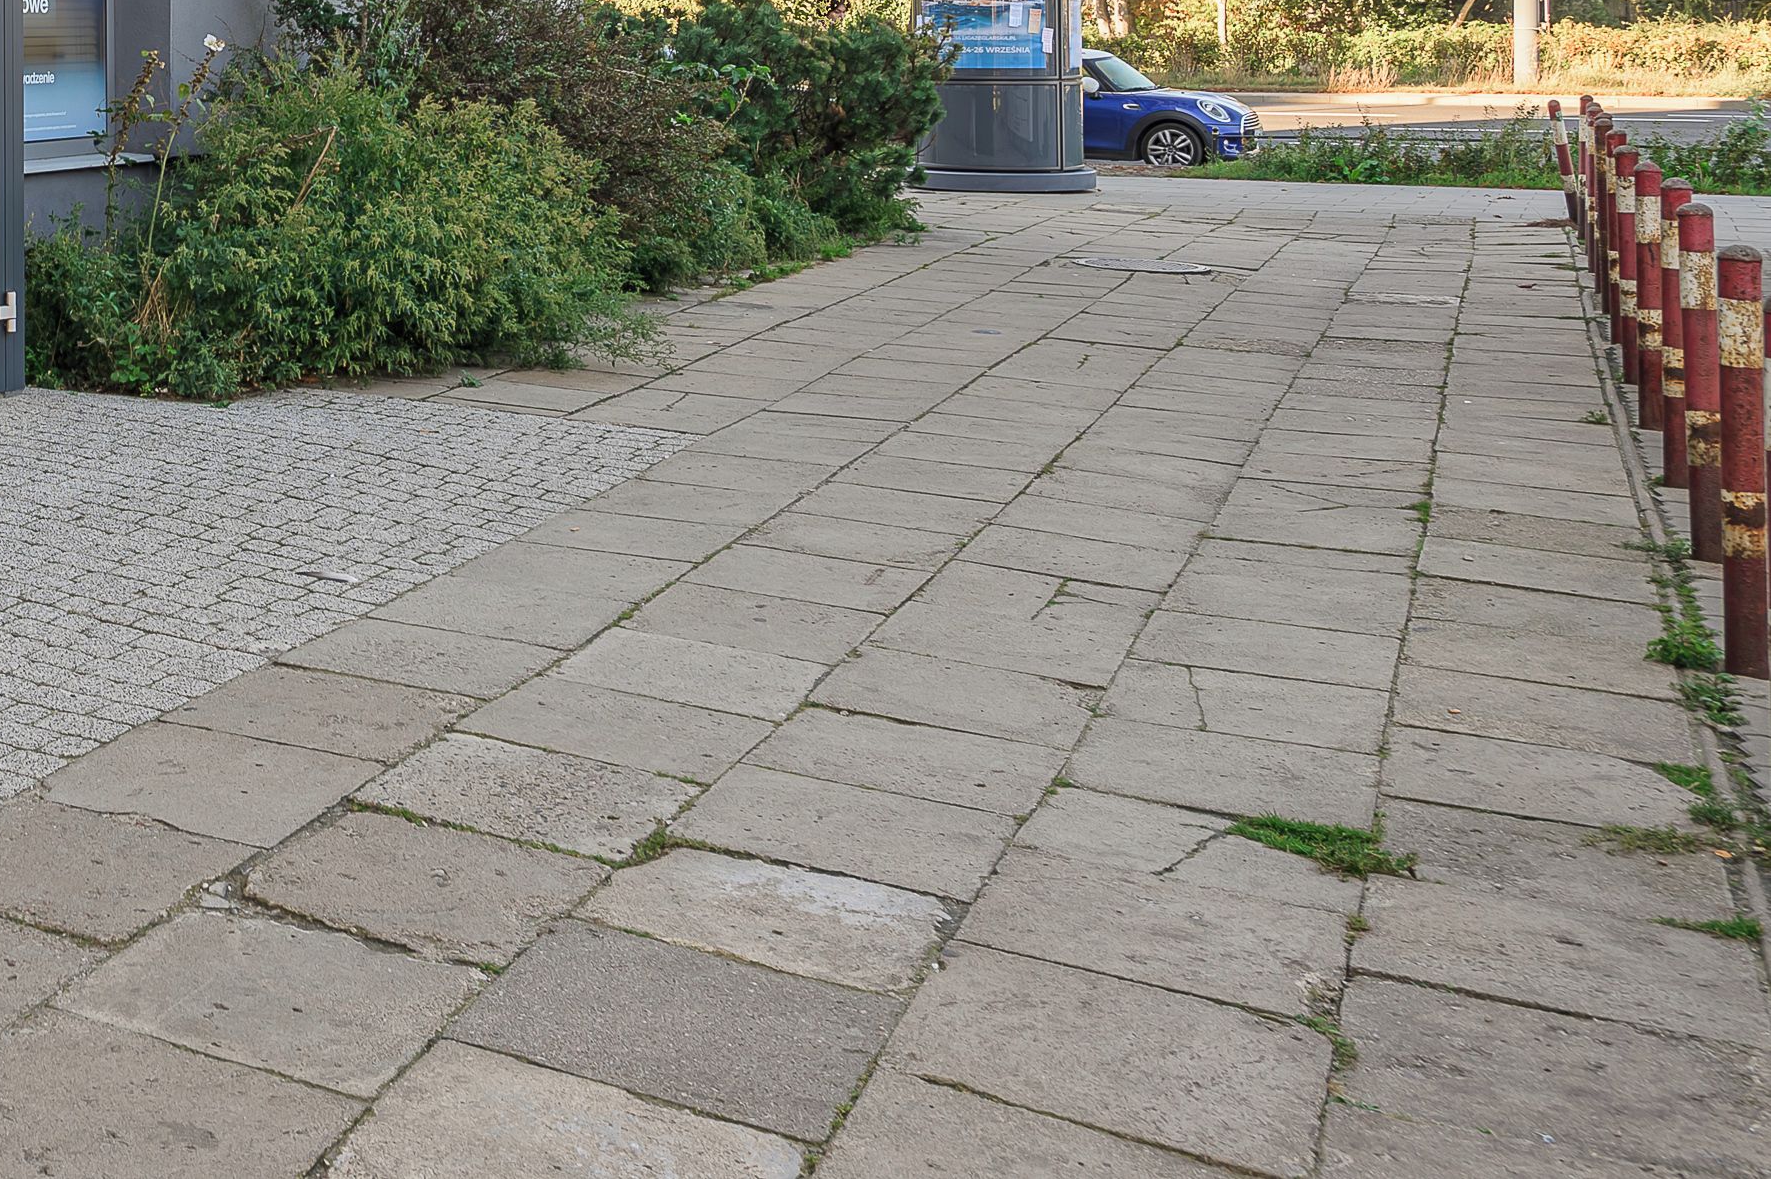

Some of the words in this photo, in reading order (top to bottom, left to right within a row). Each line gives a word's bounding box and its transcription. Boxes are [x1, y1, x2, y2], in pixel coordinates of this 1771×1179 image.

[962, 46, 984, 54] 24-26
[985, 45, 1031, 54] WRZEŚNIA
[23, 71, 55, 85] adzenie
